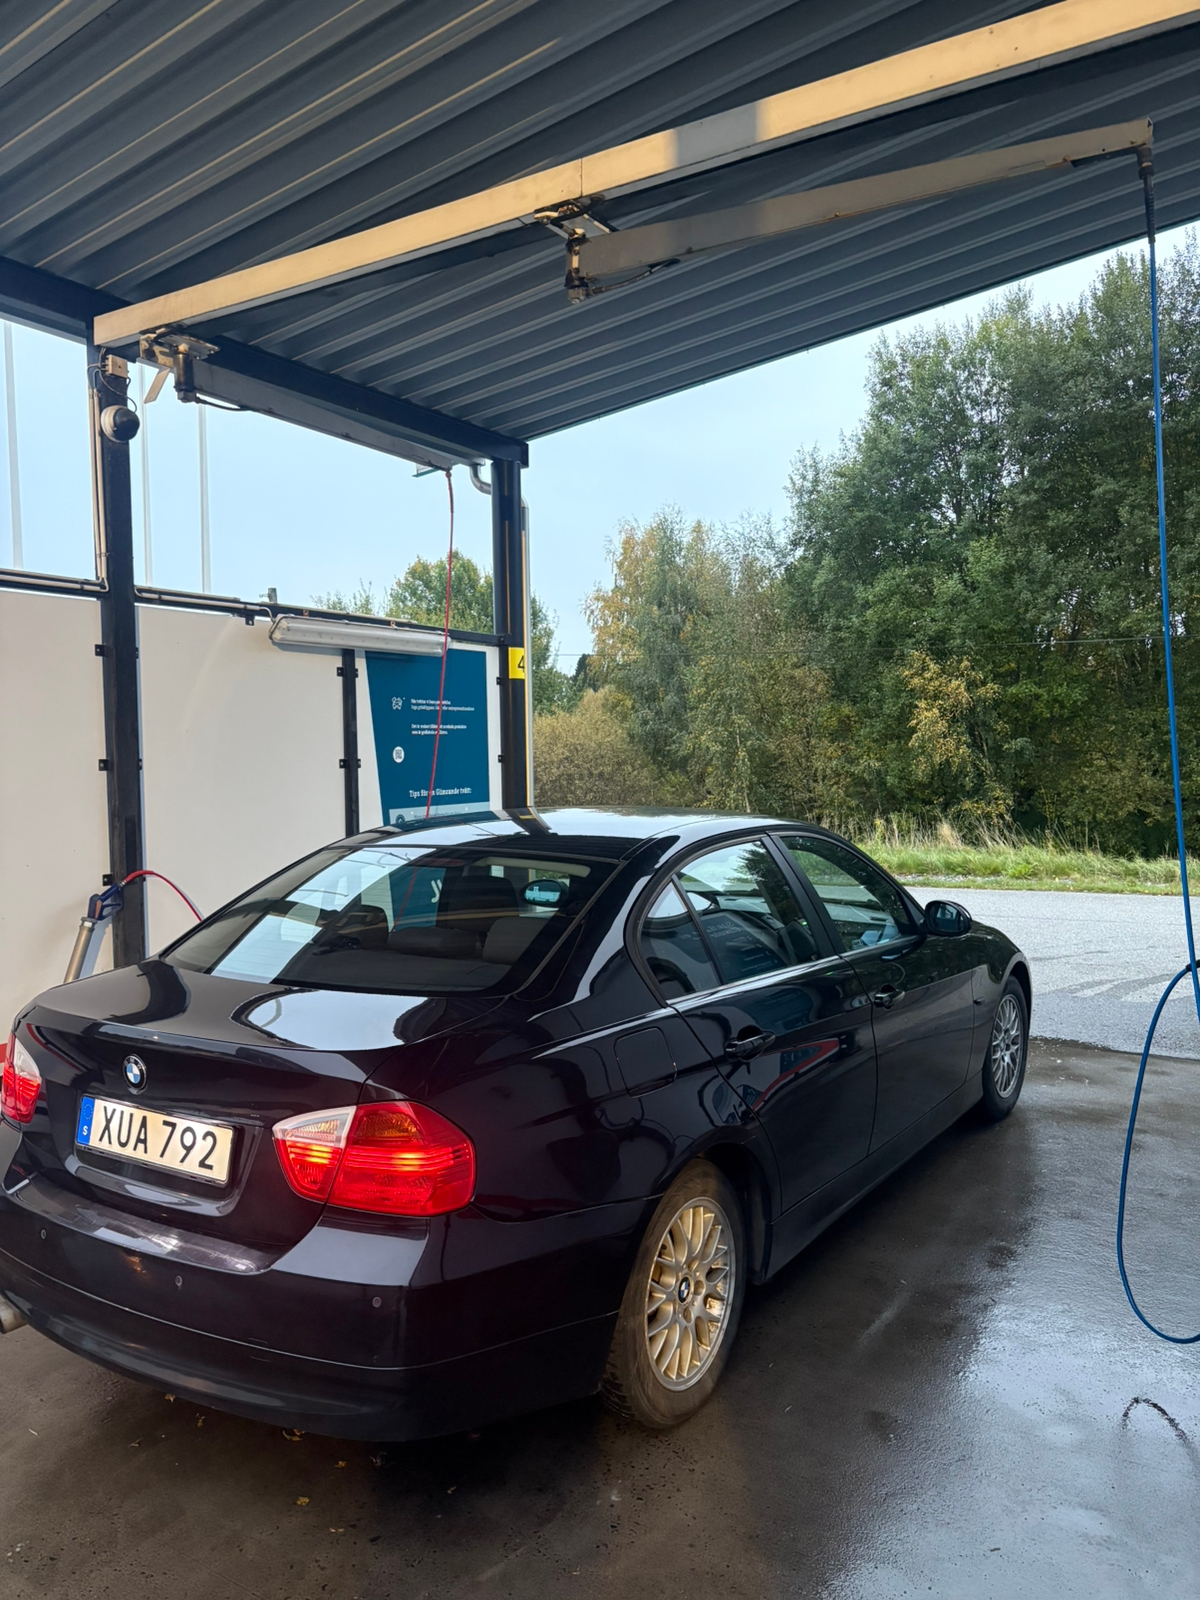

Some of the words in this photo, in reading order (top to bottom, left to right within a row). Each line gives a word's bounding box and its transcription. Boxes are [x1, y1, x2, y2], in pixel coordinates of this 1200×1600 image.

[517, 655, 525, 673] 4
[82, 1125, 89, 1136] S
[99, 1106, 148, 1154] XUA
[159, 1120, 217, 1171] 792
